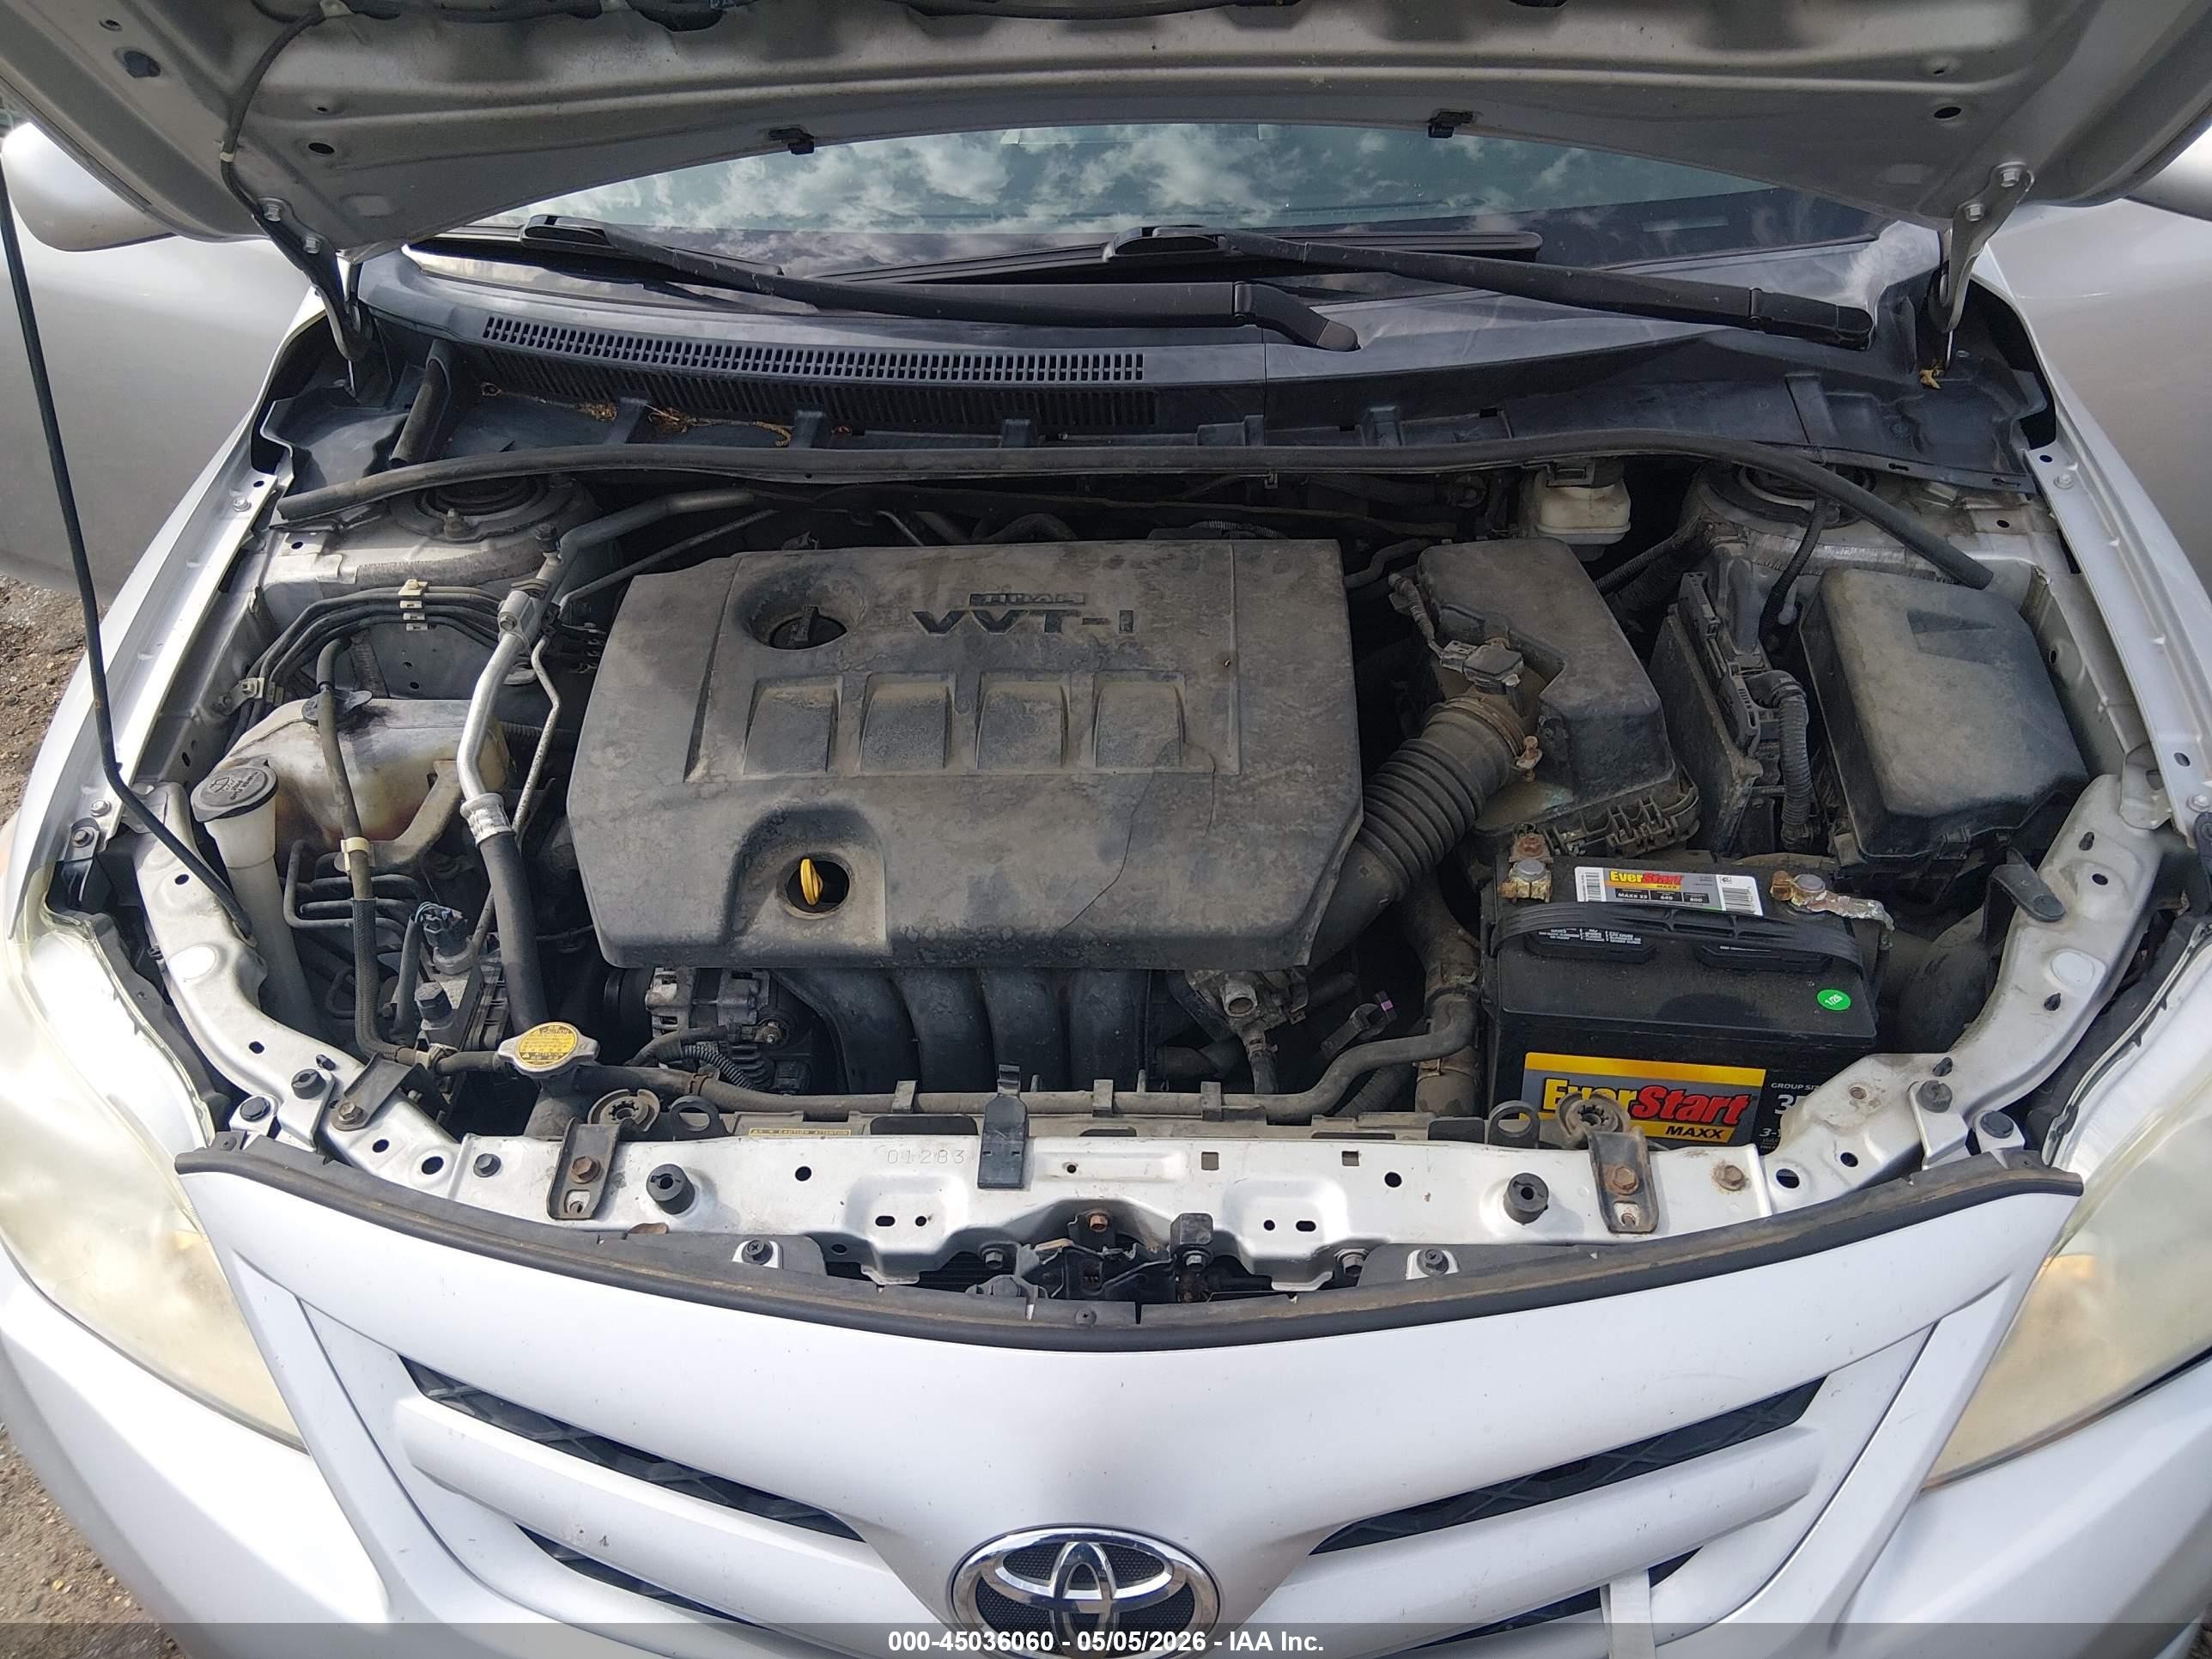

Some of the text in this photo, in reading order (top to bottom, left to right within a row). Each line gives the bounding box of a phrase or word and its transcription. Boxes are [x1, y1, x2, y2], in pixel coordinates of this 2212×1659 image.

[1610, 870, 1682, 885] EverStart
[1665, 1126, 1725, 1139] MAXX
[887, 1150, 964, 1164] 01283
